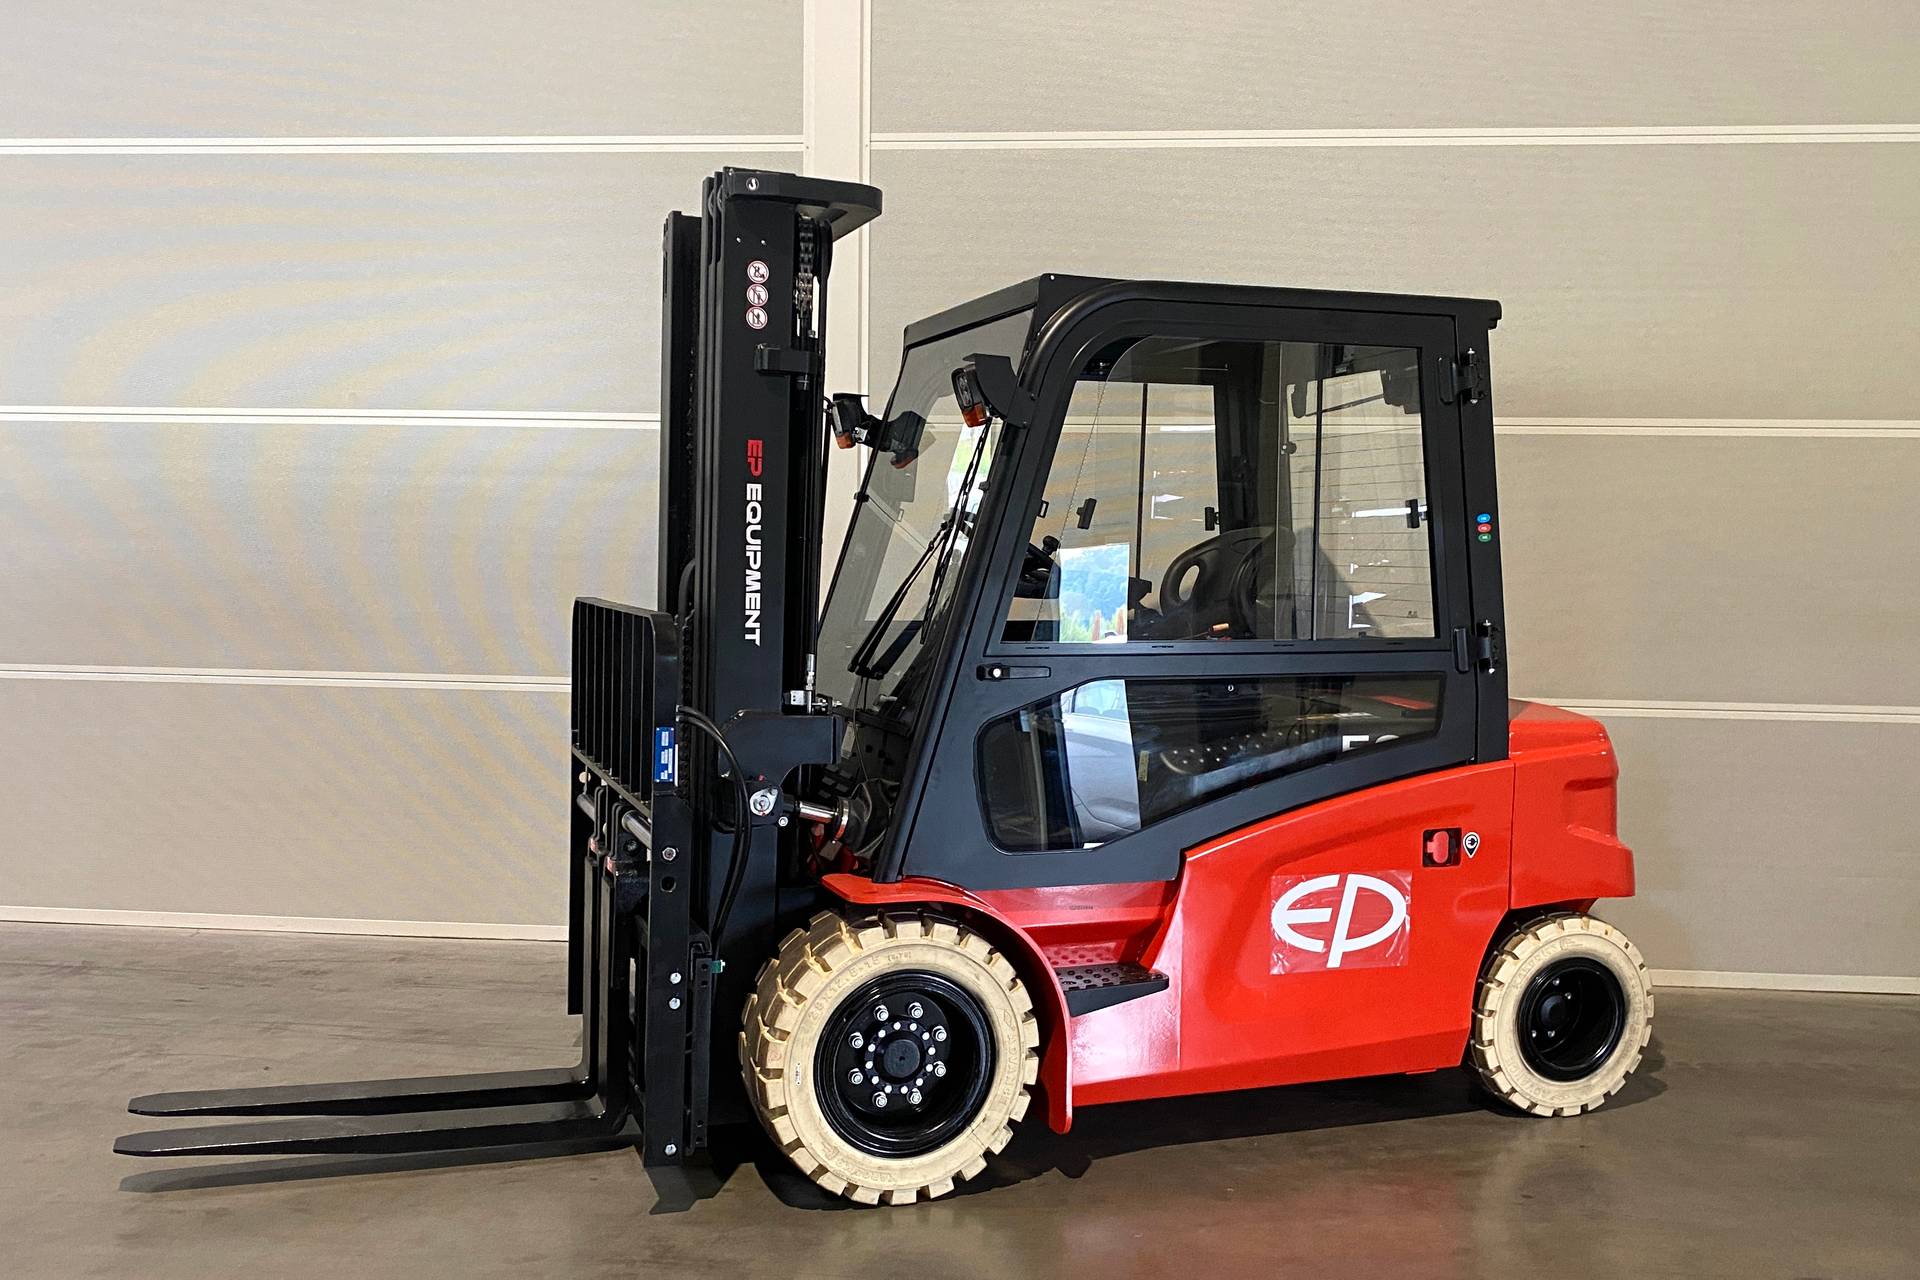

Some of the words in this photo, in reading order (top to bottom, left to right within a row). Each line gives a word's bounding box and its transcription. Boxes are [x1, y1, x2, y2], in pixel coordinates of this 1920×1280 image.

[747, 439, 763, 477] EP
[744, 483, 762, 647] EQUIPMENT
[1271, 873, 1407, 968] EP
